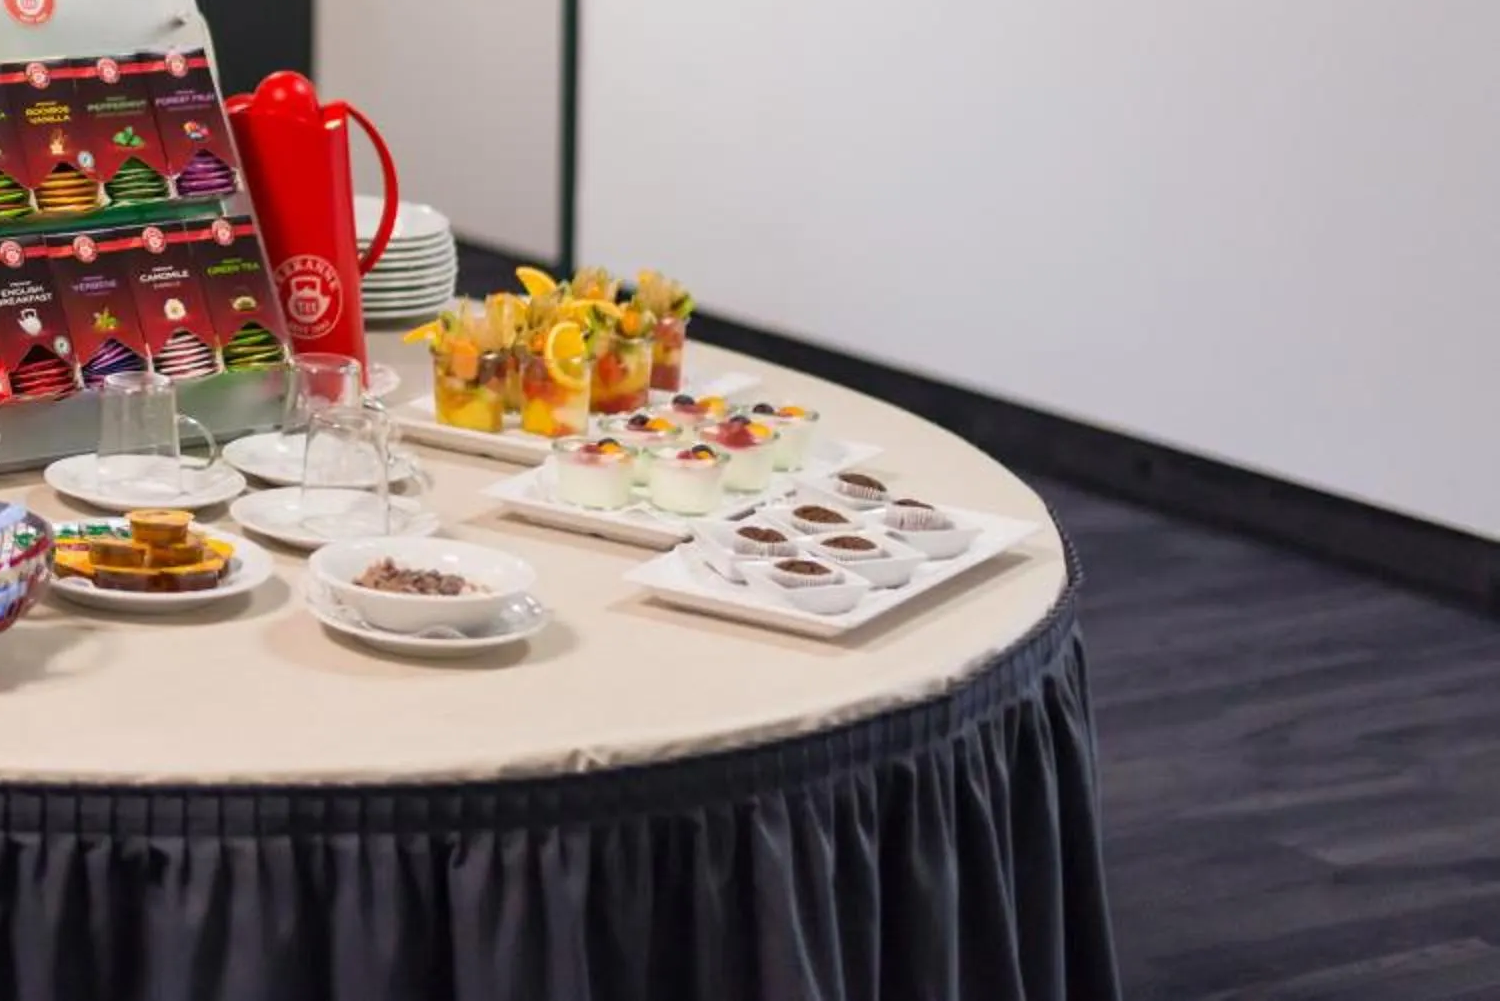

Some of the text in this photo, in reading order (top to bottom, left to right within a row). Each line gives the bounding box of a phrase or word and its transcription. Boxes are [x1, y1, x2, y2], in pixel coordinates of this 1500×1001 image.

[207, 265, 240, 276] GREEN
[241, 261, 259, 270] TEA
[139, 269, 190, 283] CAMOMILE
[0, 285, 45, 298] ENGLISH
